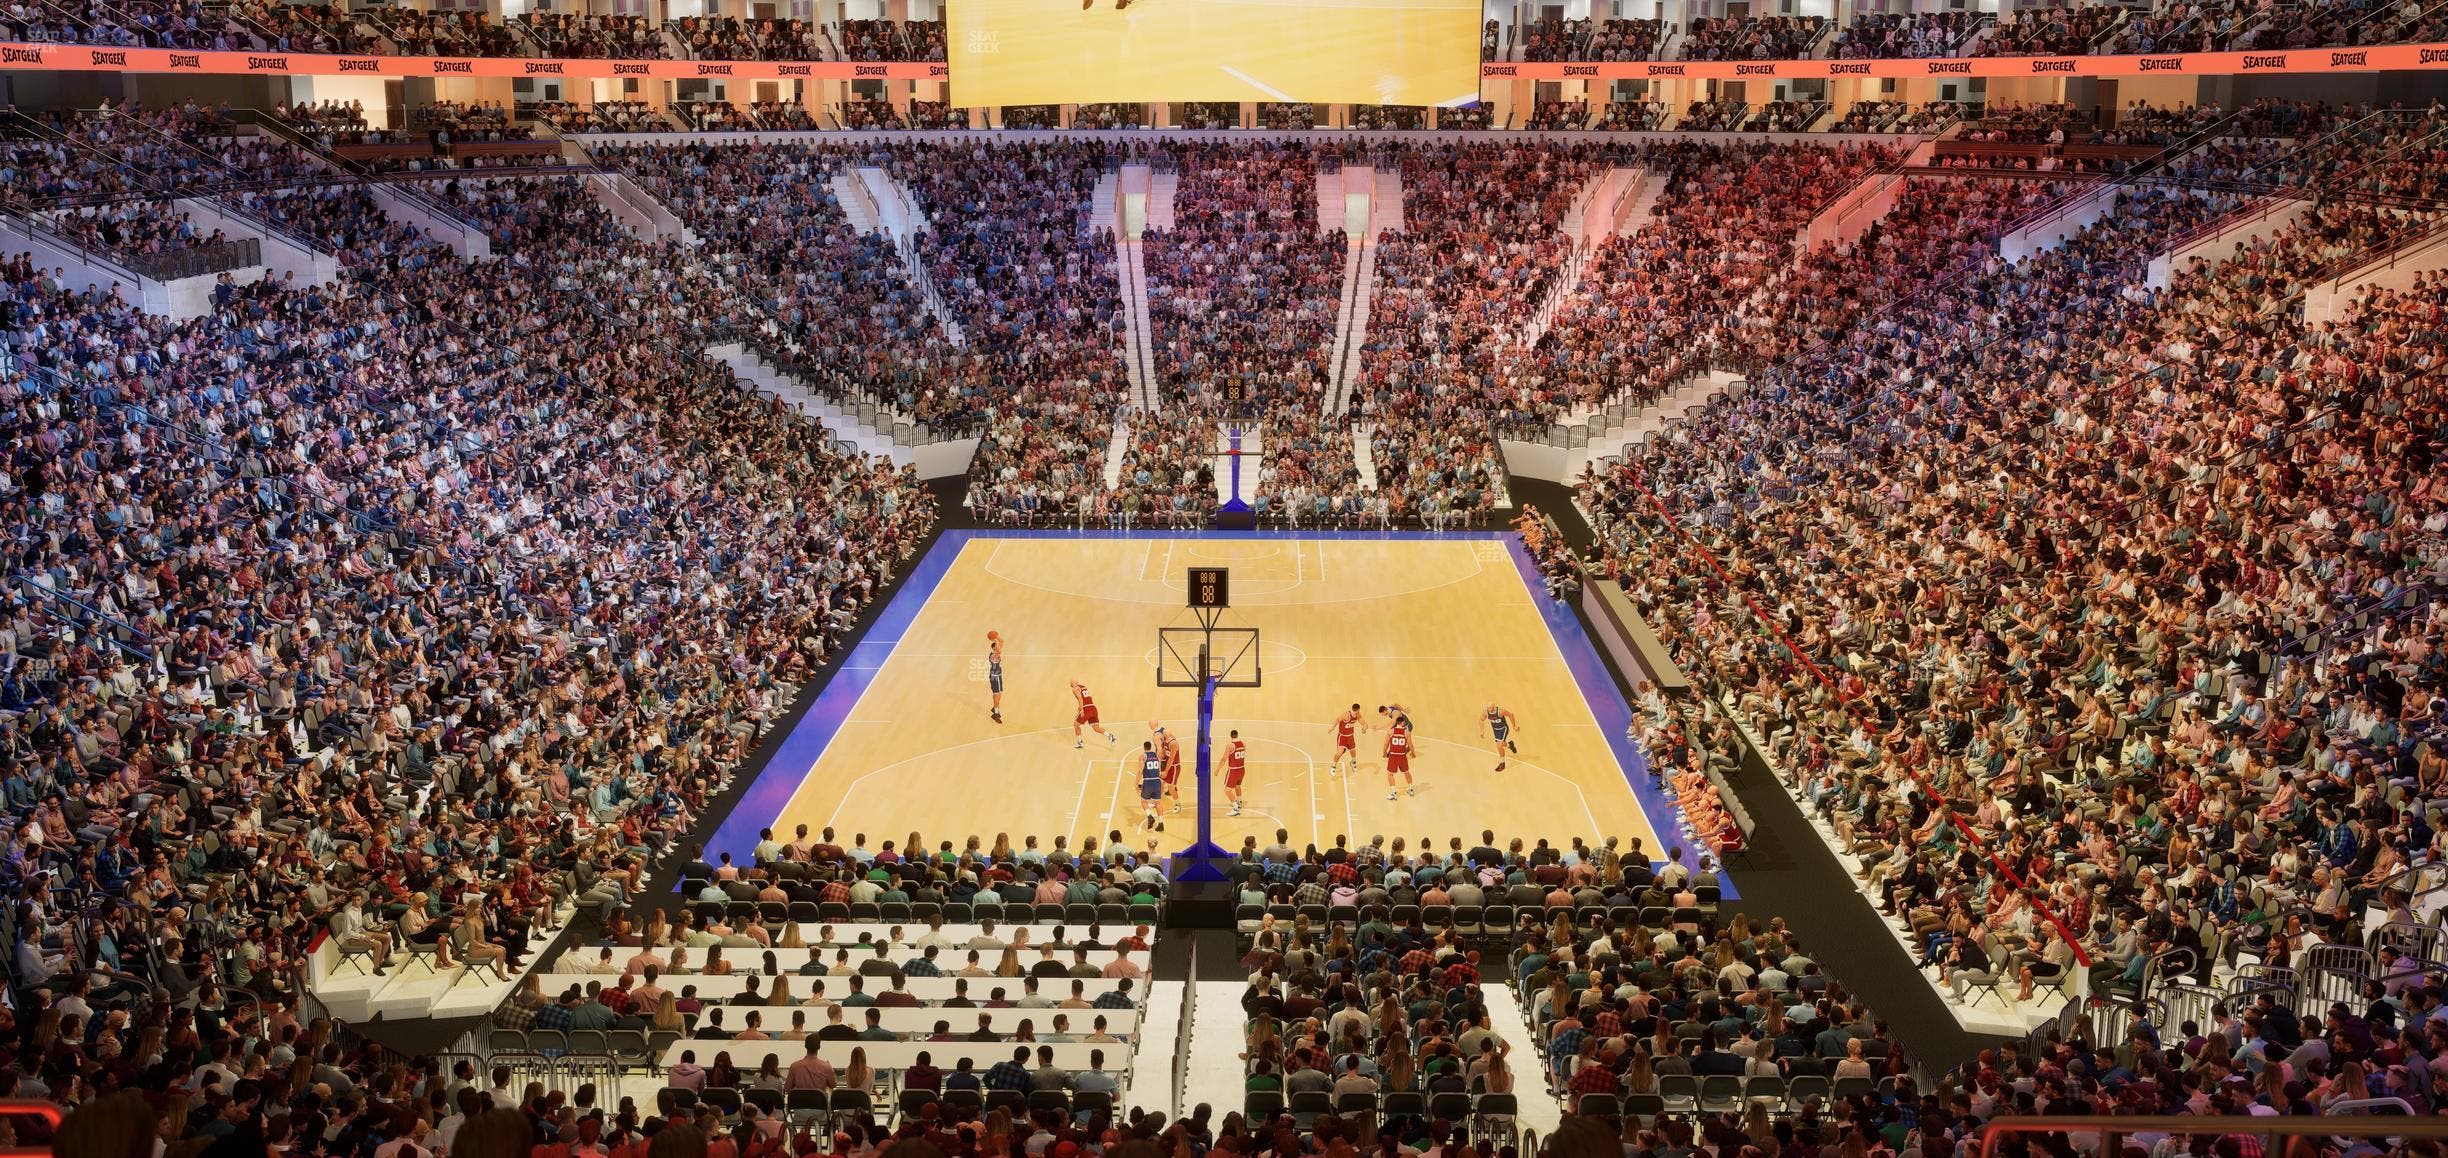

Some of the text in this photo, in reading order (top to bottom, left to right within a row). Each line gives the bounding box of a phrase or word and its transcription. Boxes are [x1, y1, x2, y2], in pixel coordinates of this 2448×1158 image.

[1, 46, 43, 65] SEATGEEK
[91, 50, 128, 67] SEATGEEK
[169, 53, 201, 69] SEATGEEK
[2242, 54, 2287, 70] SEATGEEK
[2330, 50, 2368, 67] SEATGEEK
[2419, 48, 2448, 65] SEATGE
[247, 56, 289, 71] SEATGEEK
[338, 58, 380, 73] SEATGEEK
[433, 60, 473, 74] SEATGEEK
[525, 62, 564, 74] SEATGEEK
[613, 63, 650, 75] SEATGEEK
[697, 64, 733, 76] SEATGEEK
[777, 64, 812, 76] SEATGEEK
[1647, 64, 1685, 76] SEATGEEK
[1735, 63, 1776, 76] SEATGEEK
[1829, 62, 1871, 75] SEATGEEK
[1928, 61, 1972, 74] SEATGEEK
[2031, 59, 2077, 73] SEATGEEK
[2139, 57, 2183, 72] SEATGEEK
[855, 65, 888, 76] SEATGEEK
[929, 65, 947, 77] SEATG
[1484, 65, 1518, 77] SEATGEEK
[1563, 65, 1599, 77] SEATGEEK
[1202, 585, 1215, 604] 88
